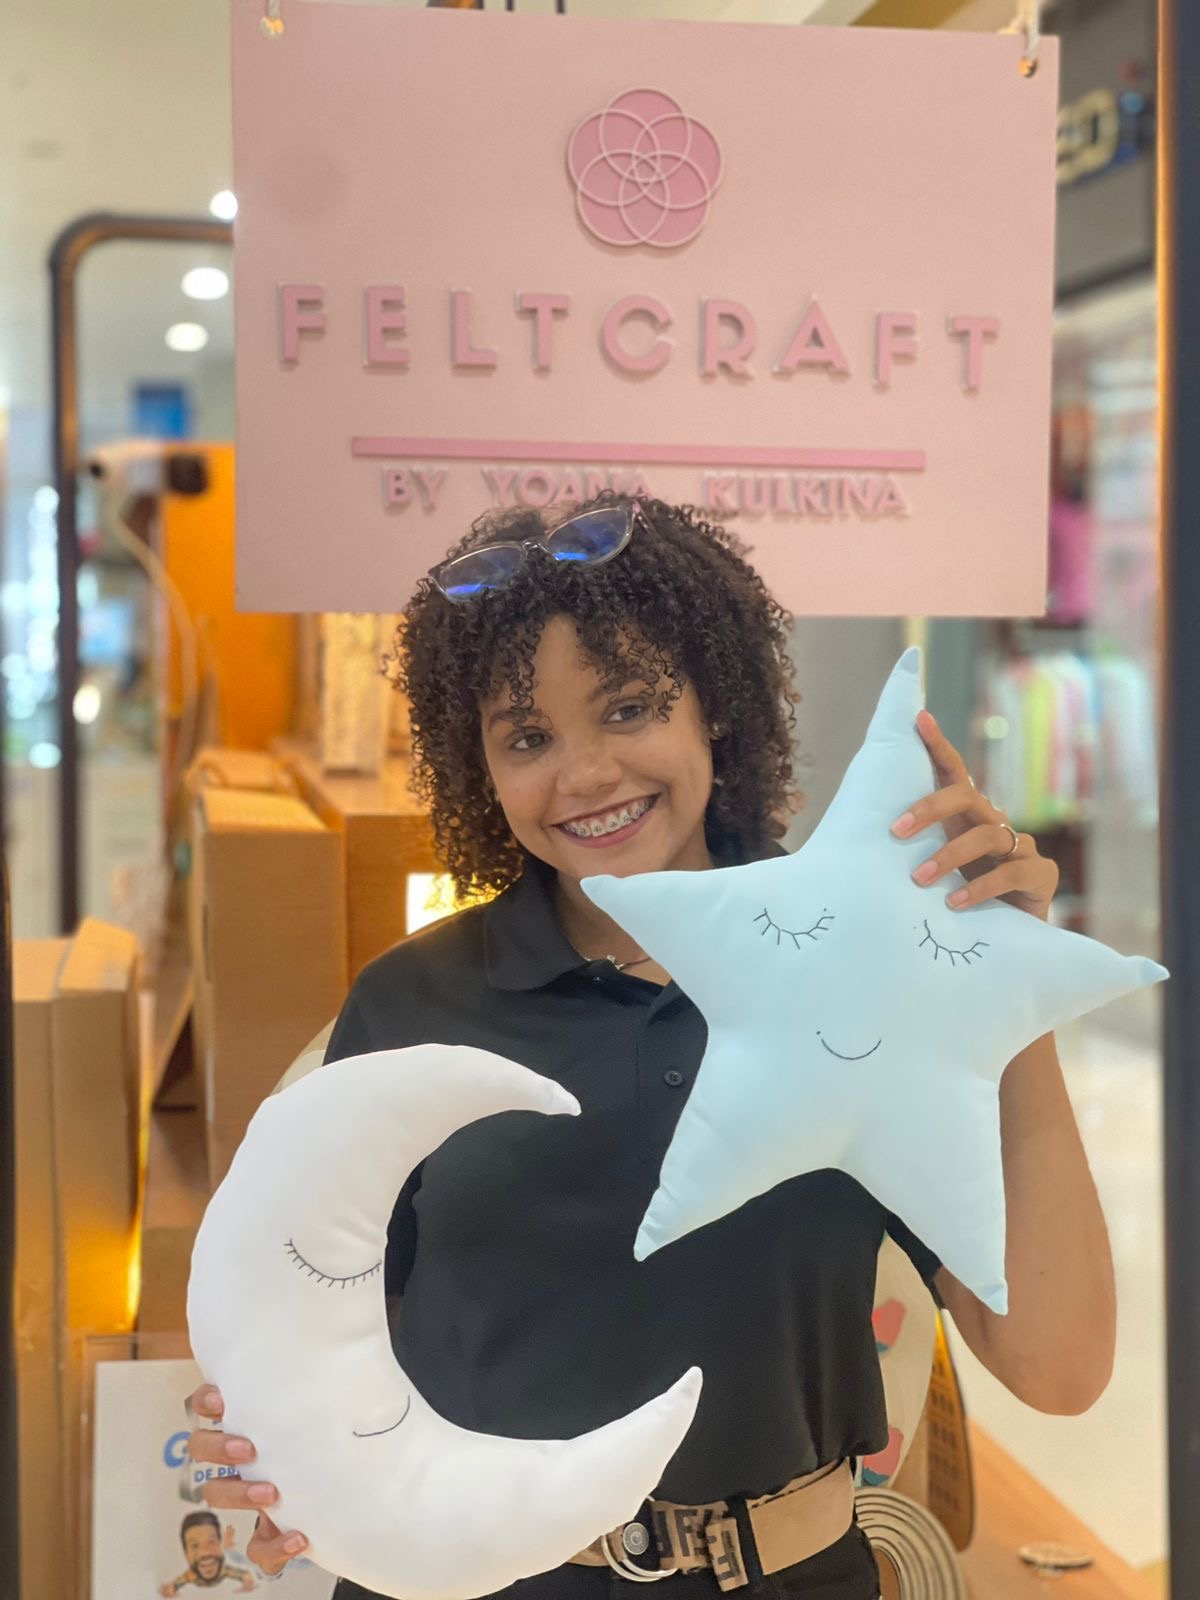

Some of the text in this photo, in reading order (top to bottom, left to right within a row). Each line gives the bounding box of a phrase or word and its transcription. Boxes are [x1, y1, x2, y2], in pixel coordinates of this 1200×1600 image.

[278, 284, 999, 391] FELTCRAFT
[382, 465, 448, 510] BY
[703, 469, 907, 514] KULKINA
